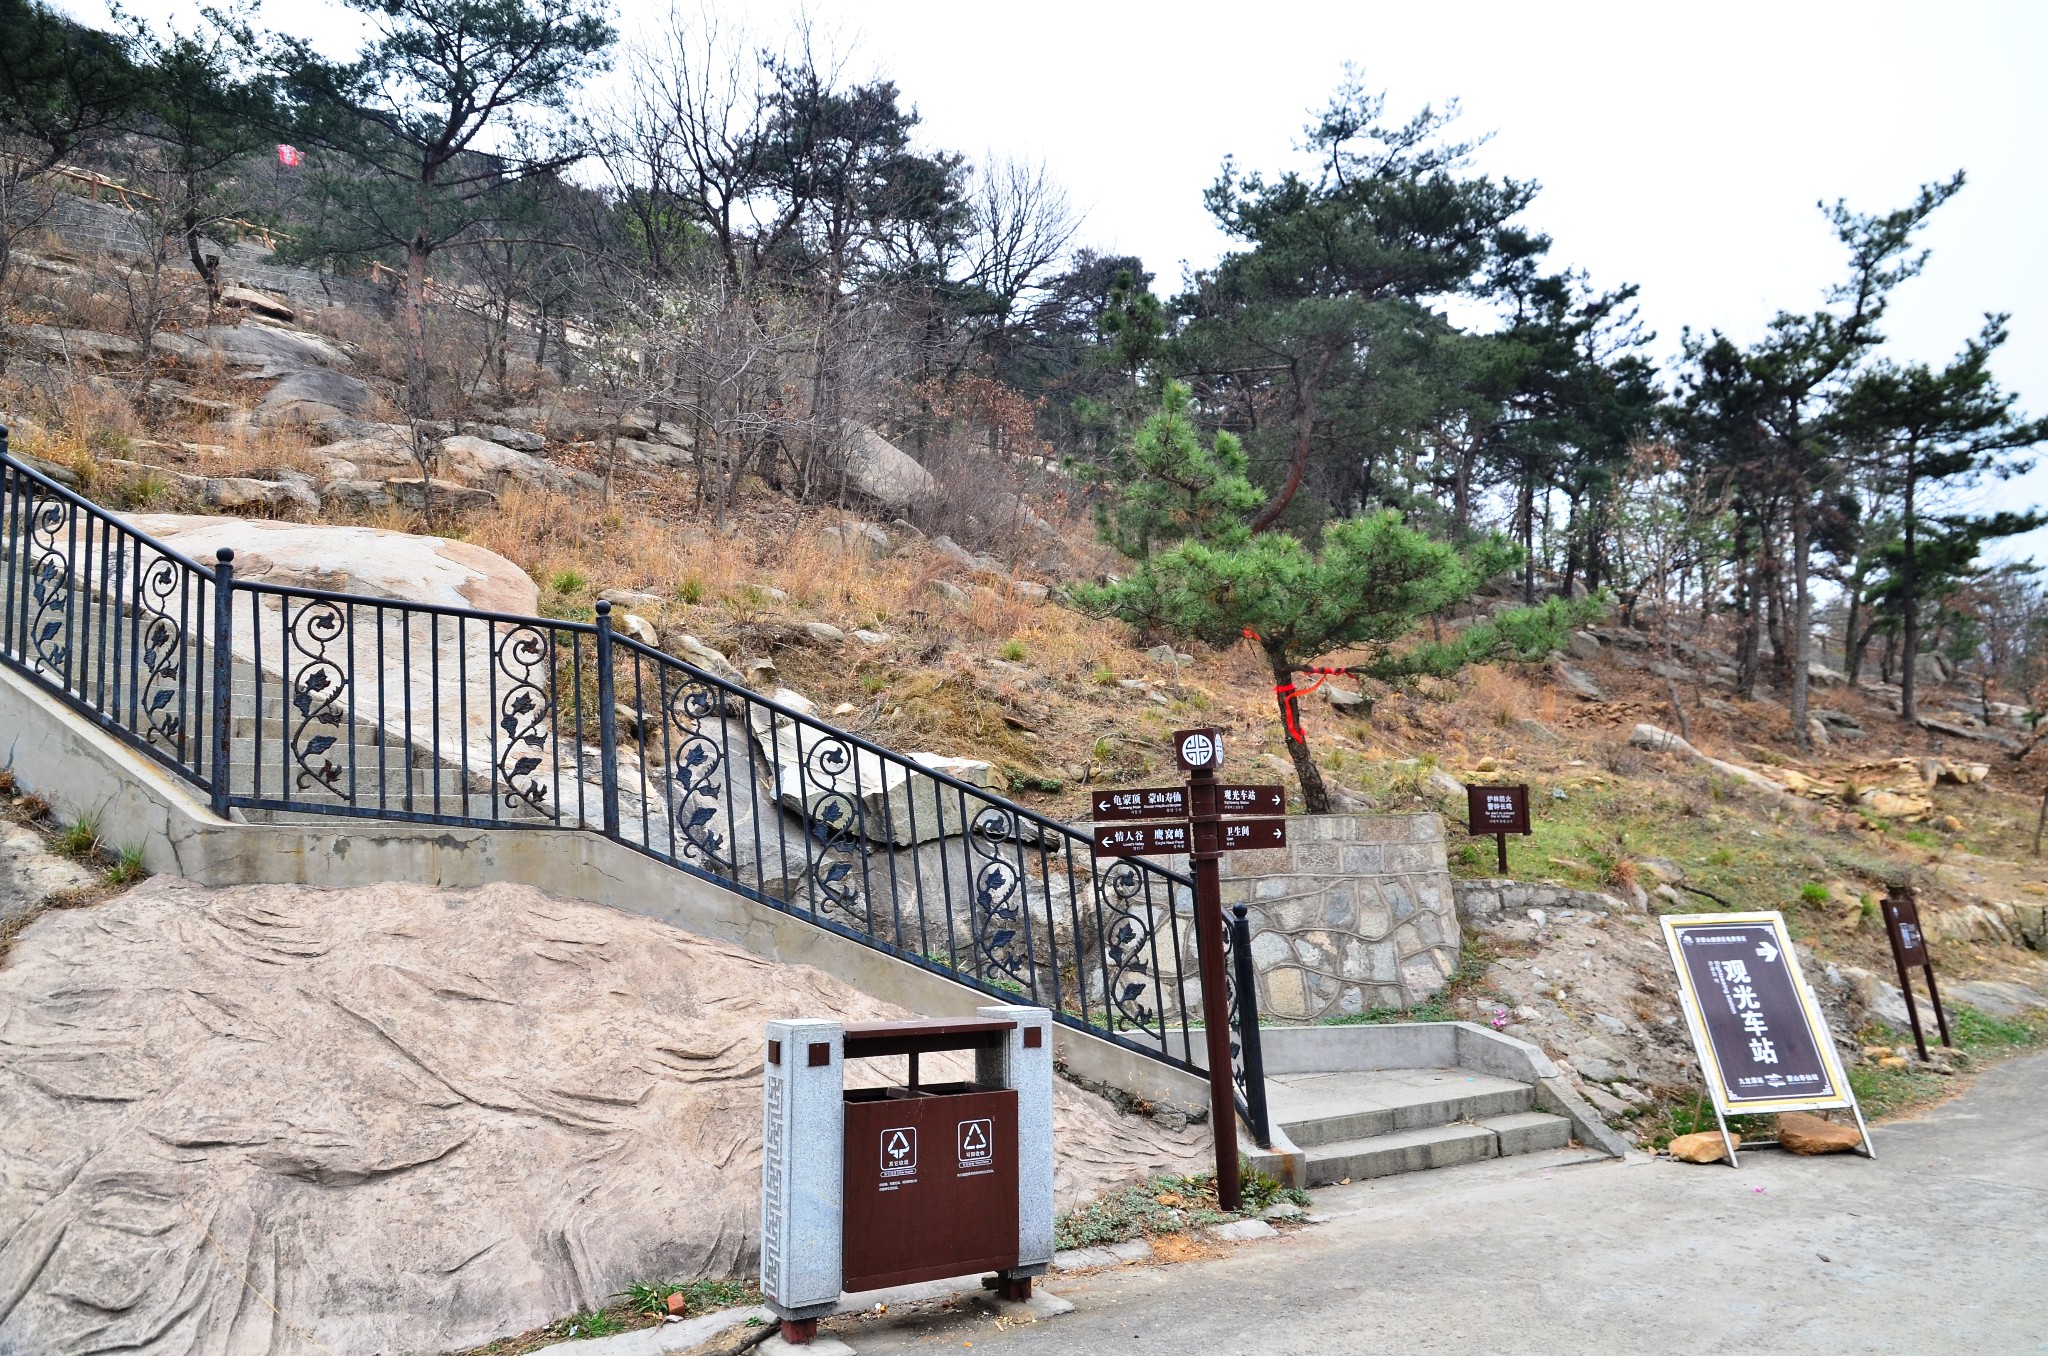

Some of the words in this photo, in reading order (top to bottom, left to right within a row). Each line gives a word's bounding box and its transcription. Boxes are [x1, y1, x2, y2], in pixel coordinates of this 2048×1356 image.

[1113, 794, 1141, 806] 龟蒙顶
[1148, 792, 1181, 804] 蒙山寿仙
[1224, 790, 1256, 800] 观光车站
[1115, 831, 1143, 842] 情人谷
[1154, 828, 1184, 840] 鹰窝峰
[1226, 826, 1250, 836] 卫生间
[1721, 959, 1779, 1064] 观光车站
